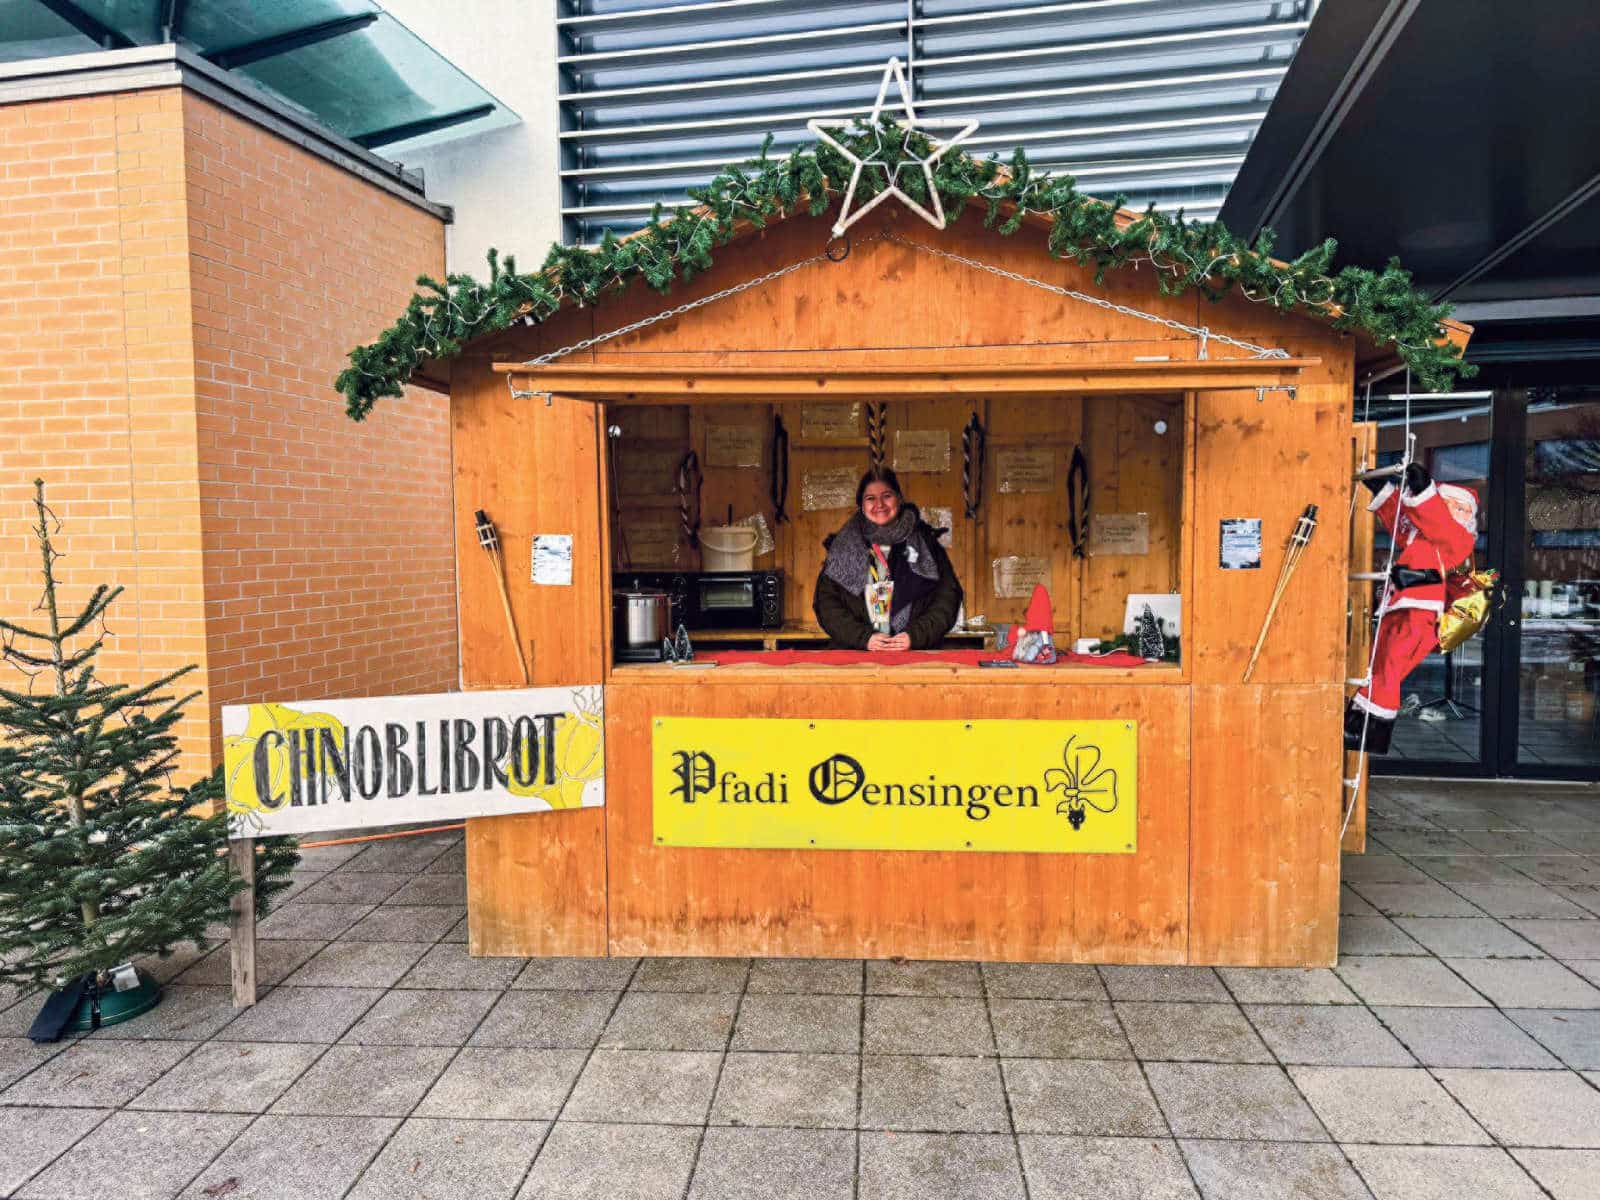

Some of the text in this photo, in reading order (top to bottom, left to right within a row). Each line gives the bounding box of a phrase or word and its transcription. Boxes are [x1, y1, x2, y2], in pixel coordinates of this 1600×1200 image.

[254, 713, 566, 808] CHNOBLIBROT
[671, 750, 1039, 820] Pfadi Oensingen
